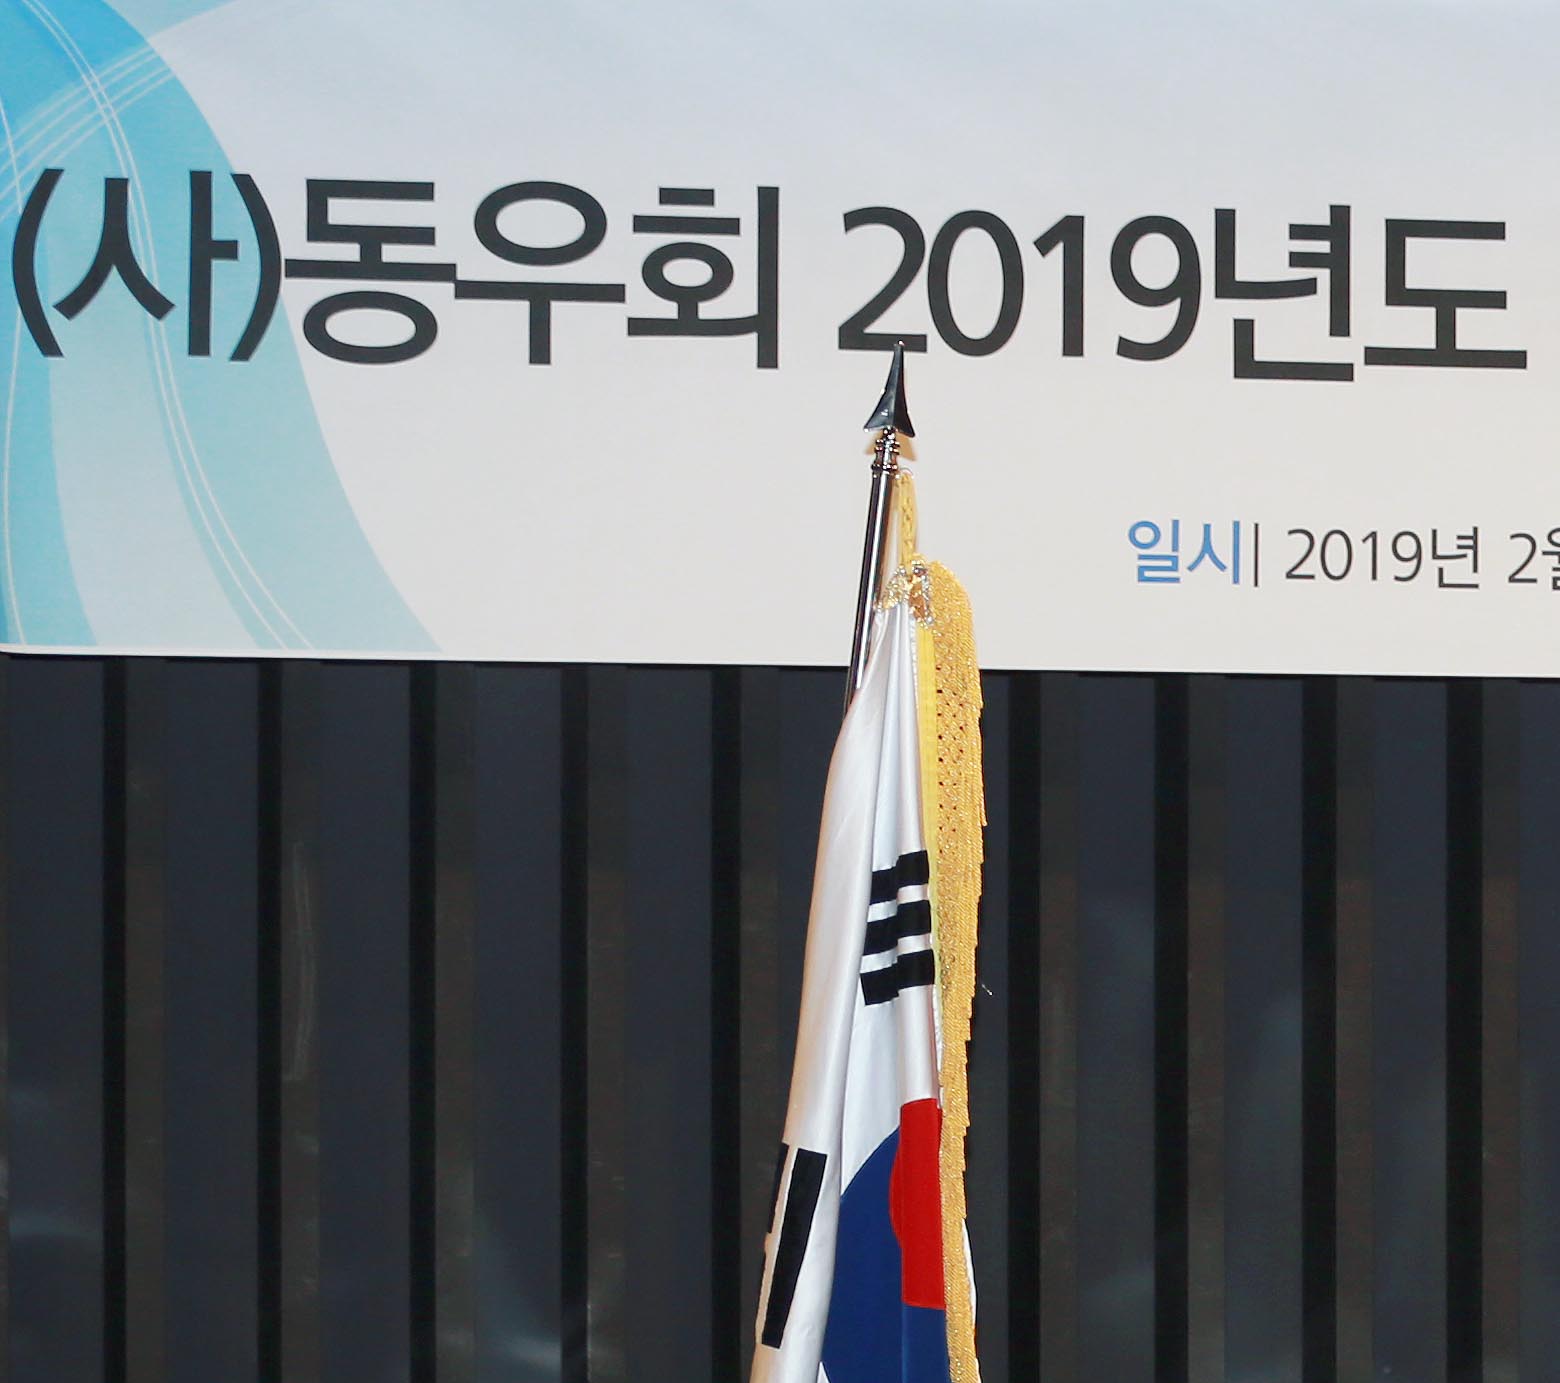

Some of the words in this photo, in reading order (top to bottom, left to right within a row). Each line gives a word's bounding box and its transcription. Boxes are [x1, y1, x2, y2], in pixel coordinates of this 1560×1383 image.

[11, 167, 781, 370] (사)동우회
[837, 204, 1528, 382] 2019년도
[1284, 526, 1481, 589] 2019년
